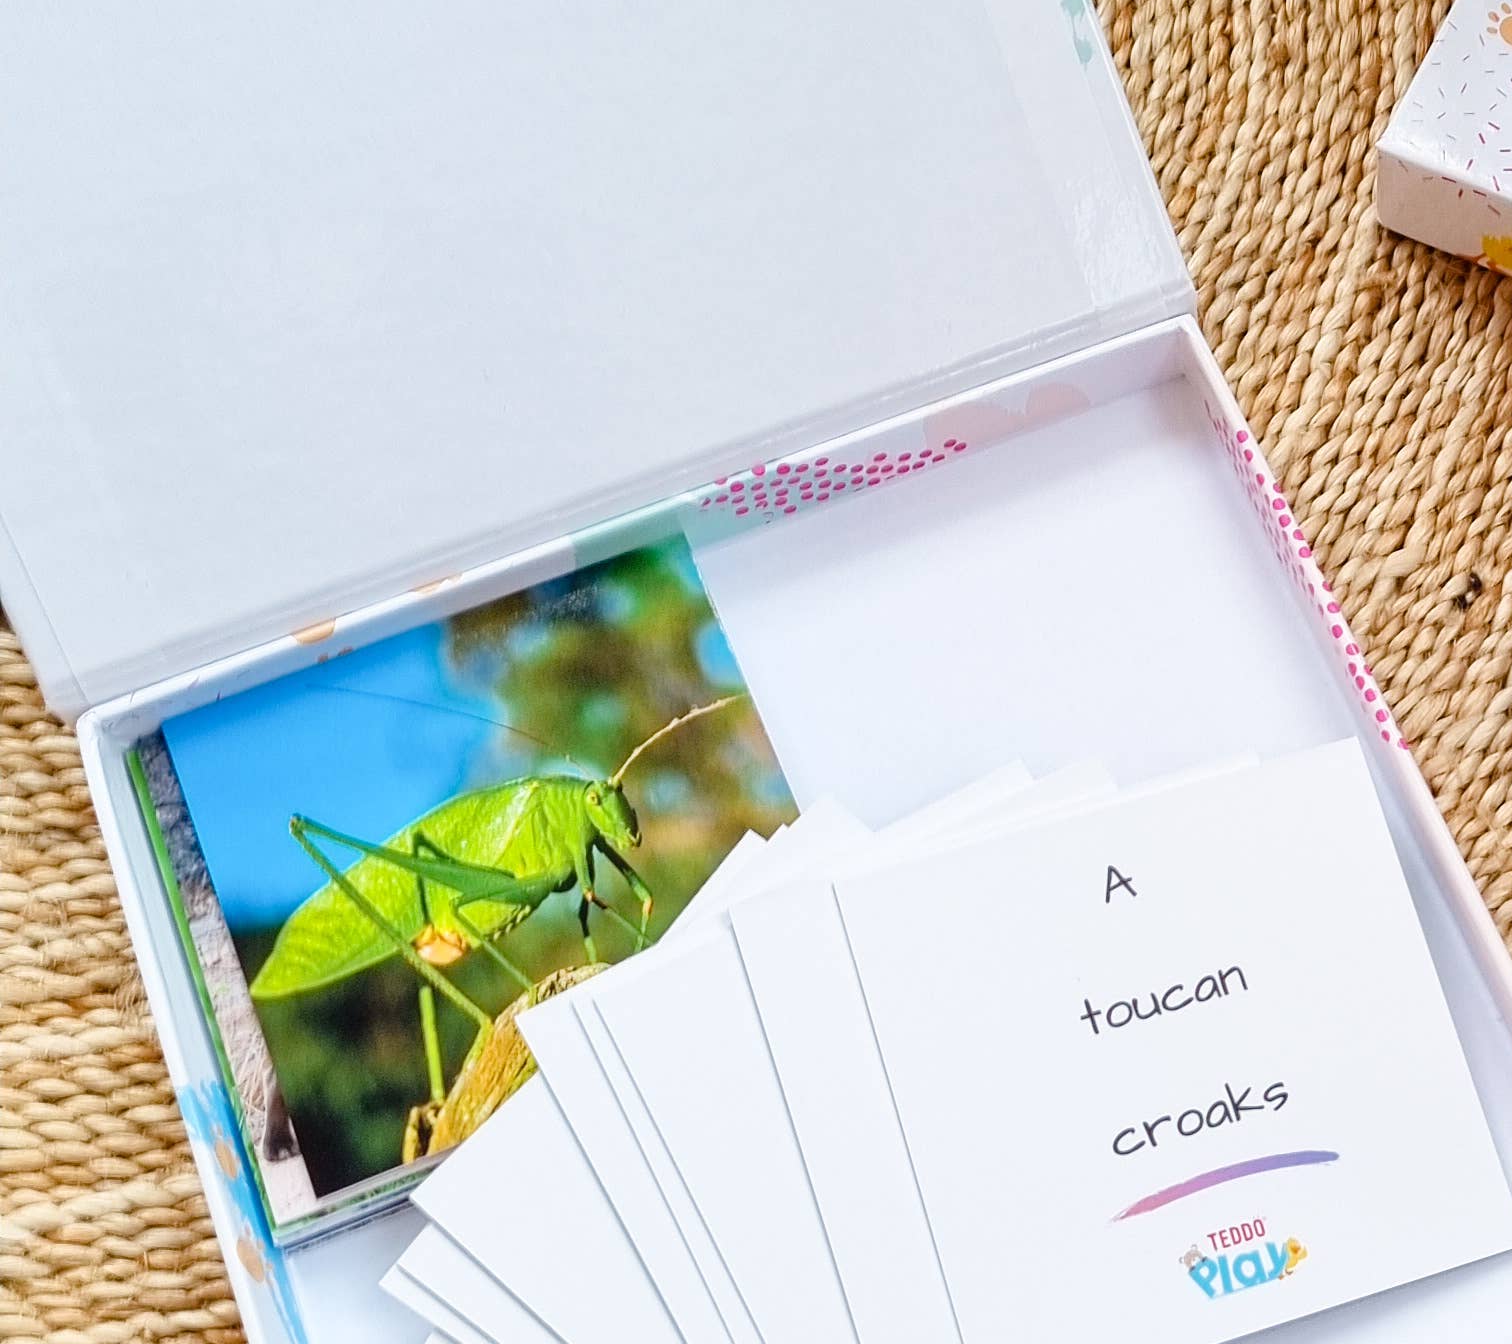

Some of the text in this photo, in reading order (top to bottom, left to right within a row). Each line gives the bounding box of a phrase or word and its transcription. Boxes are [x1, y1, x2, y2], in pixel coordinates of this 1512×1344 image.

[1105, 864, 1138, 904] A
[1080, 965, 1249, 1035] toucan
[1112, 1081, 1289, 1156] croaks
[1188, 1241, 1287, 1299] Play
